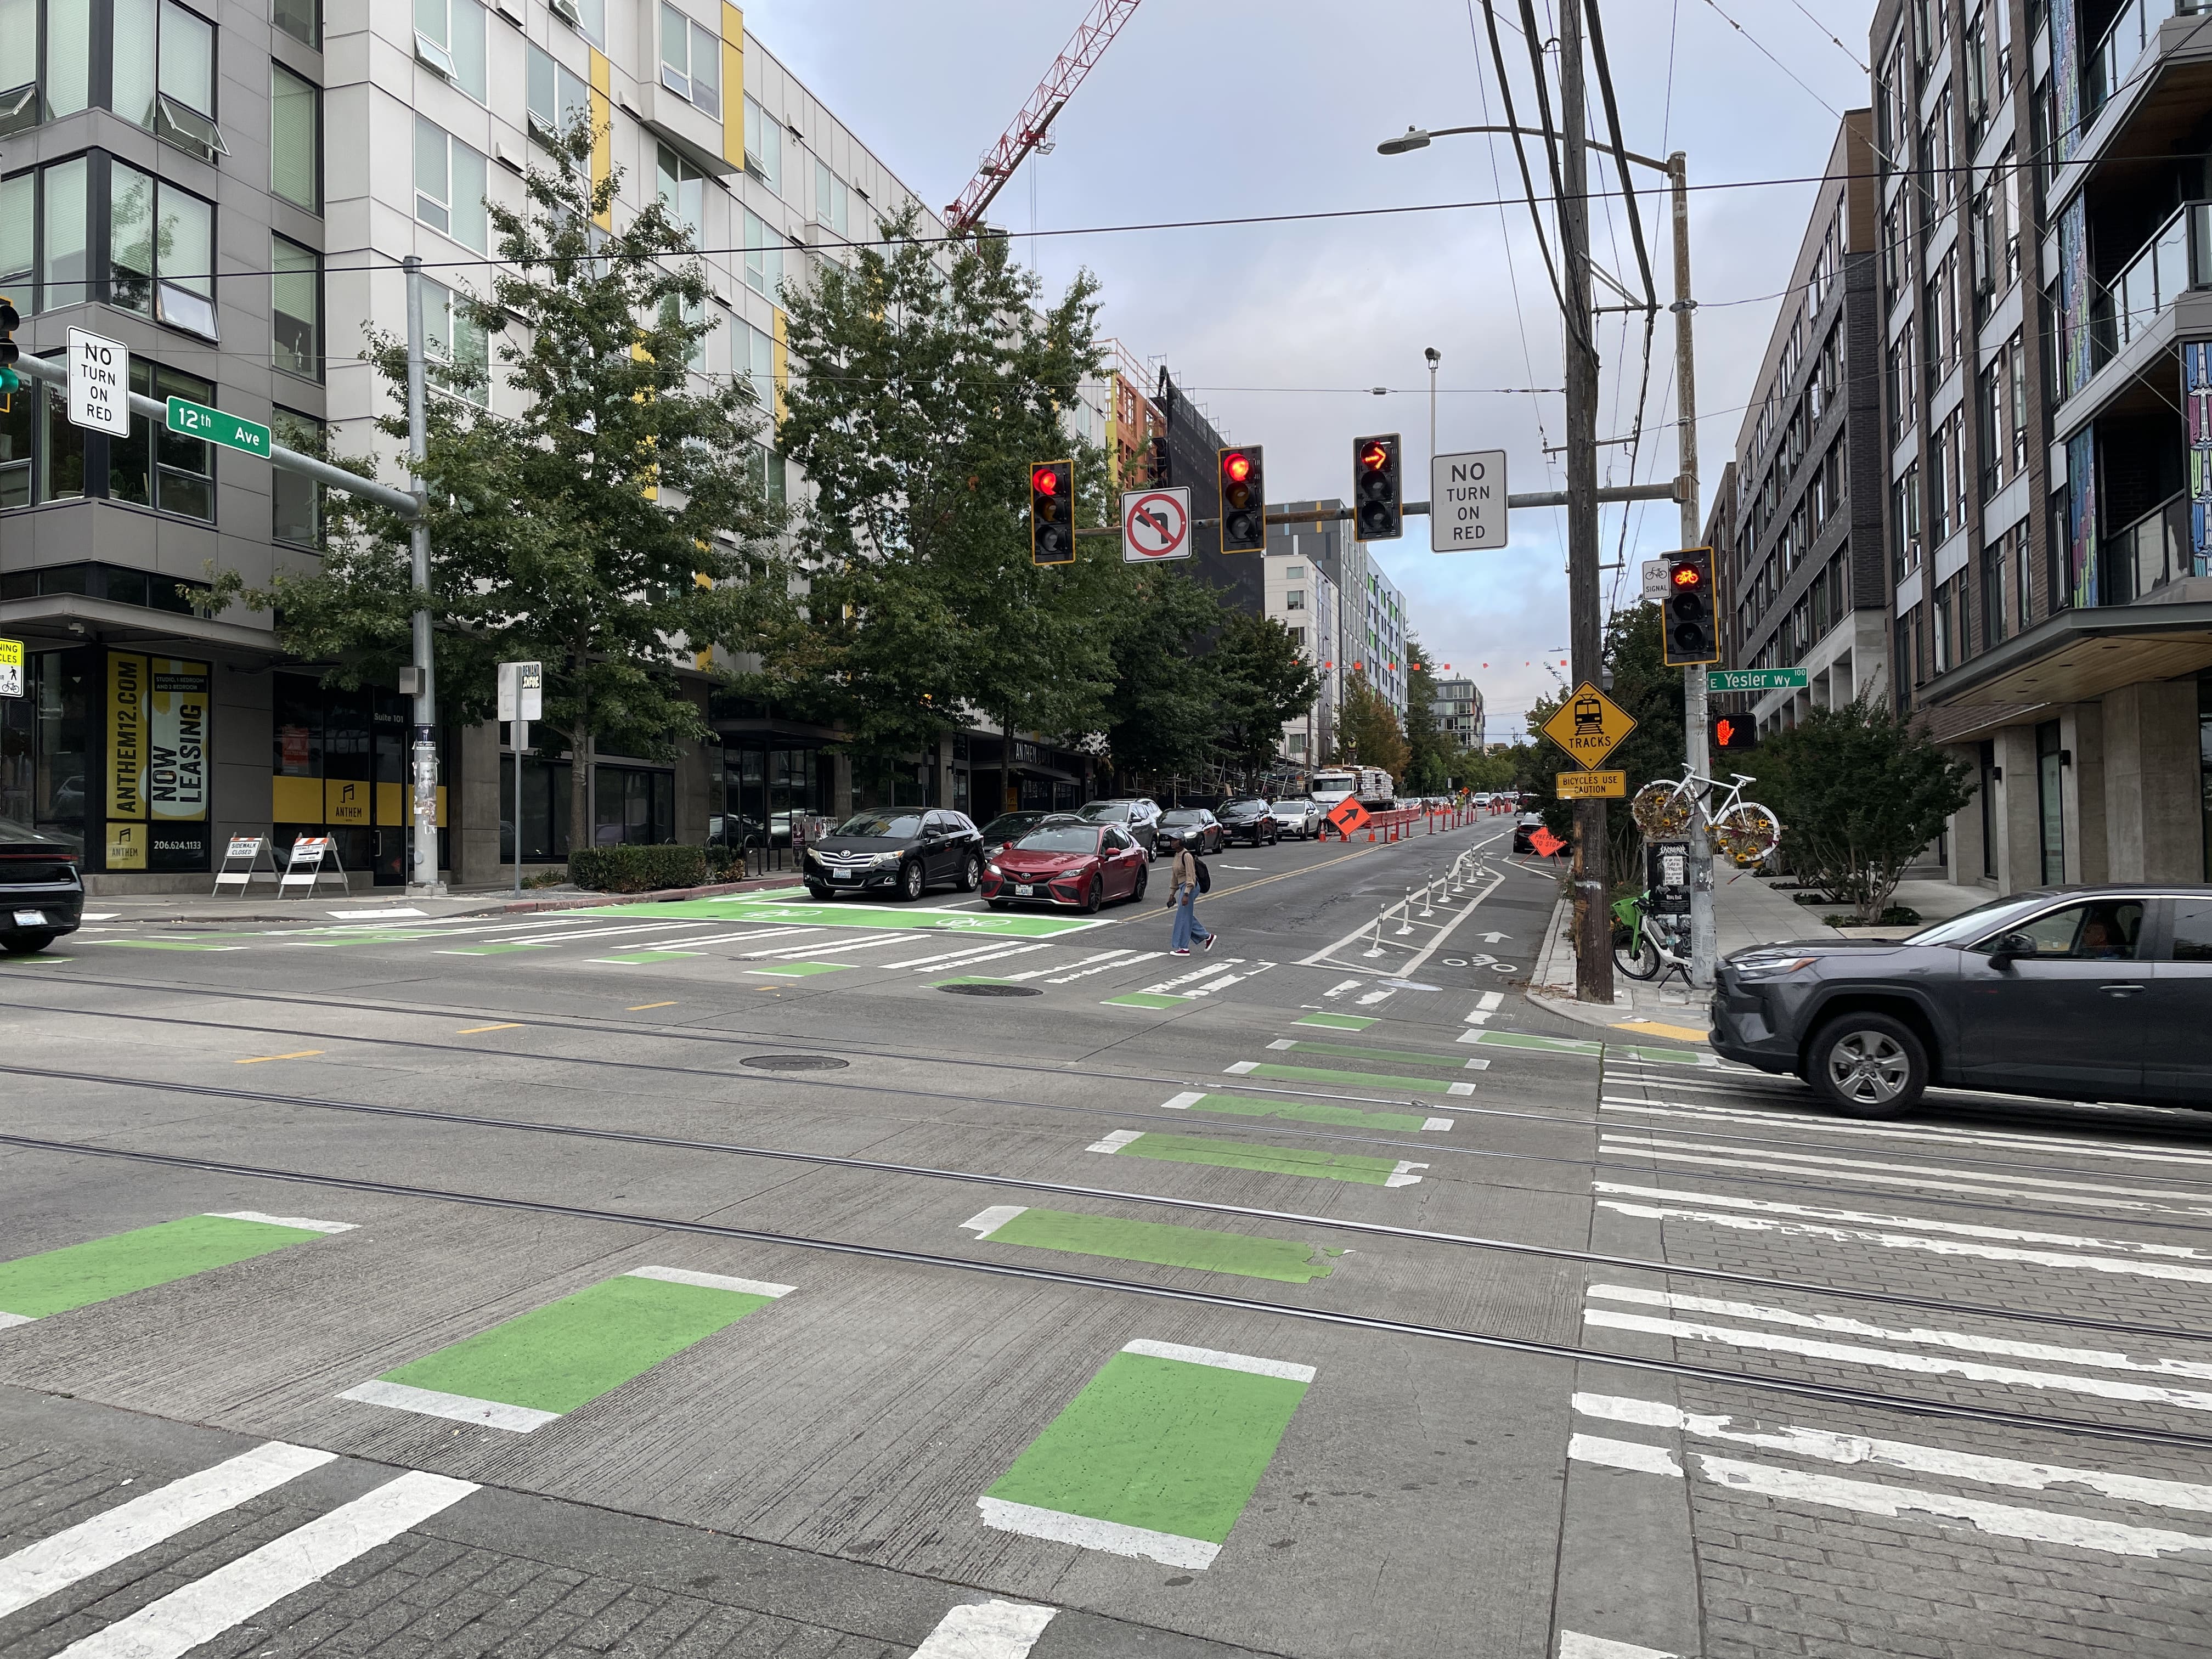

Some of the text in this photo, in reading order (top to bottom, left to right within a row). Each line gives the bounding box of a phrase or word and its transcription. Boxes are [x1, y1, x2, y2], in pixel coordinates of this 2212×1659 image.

[86, 342, 112, 365] NO
[81, 364, 115, 386] TURN
[90, 386, 108, 402] ON
[87, 403, 112, 421] RED
[179, 407, 260, 446] 12th Ave
[1452, 462, 1485, 482] NO
[1446, 486, 1489, 502] TURN
[1458, 506, 1480, 521] ON
[1454, 525, 1486, 540] RED
[1710, 678, 1718, 689] E
[1724, 673, 1767, 687] Yesler
[1774, 675, 1791, 687] Wy
[374, 713, 404, 723] Suite 101
[116, 661, 137, 814] ANTHEM12.COM
[1568, 736, 1611, 748] TRACKS
[179, 704, 202, 803] LEASING
[153, 746, 177, 802] NOW
[1563, 776, 1598, 786] BICYCLES
[1575, 785, 1606, 793] CAUTION
[335, 806, 362, 817] ANTHEM
[111, 848, 138, 857] ANTHEM
[154, 840, 201, 850] 206.624.1133
